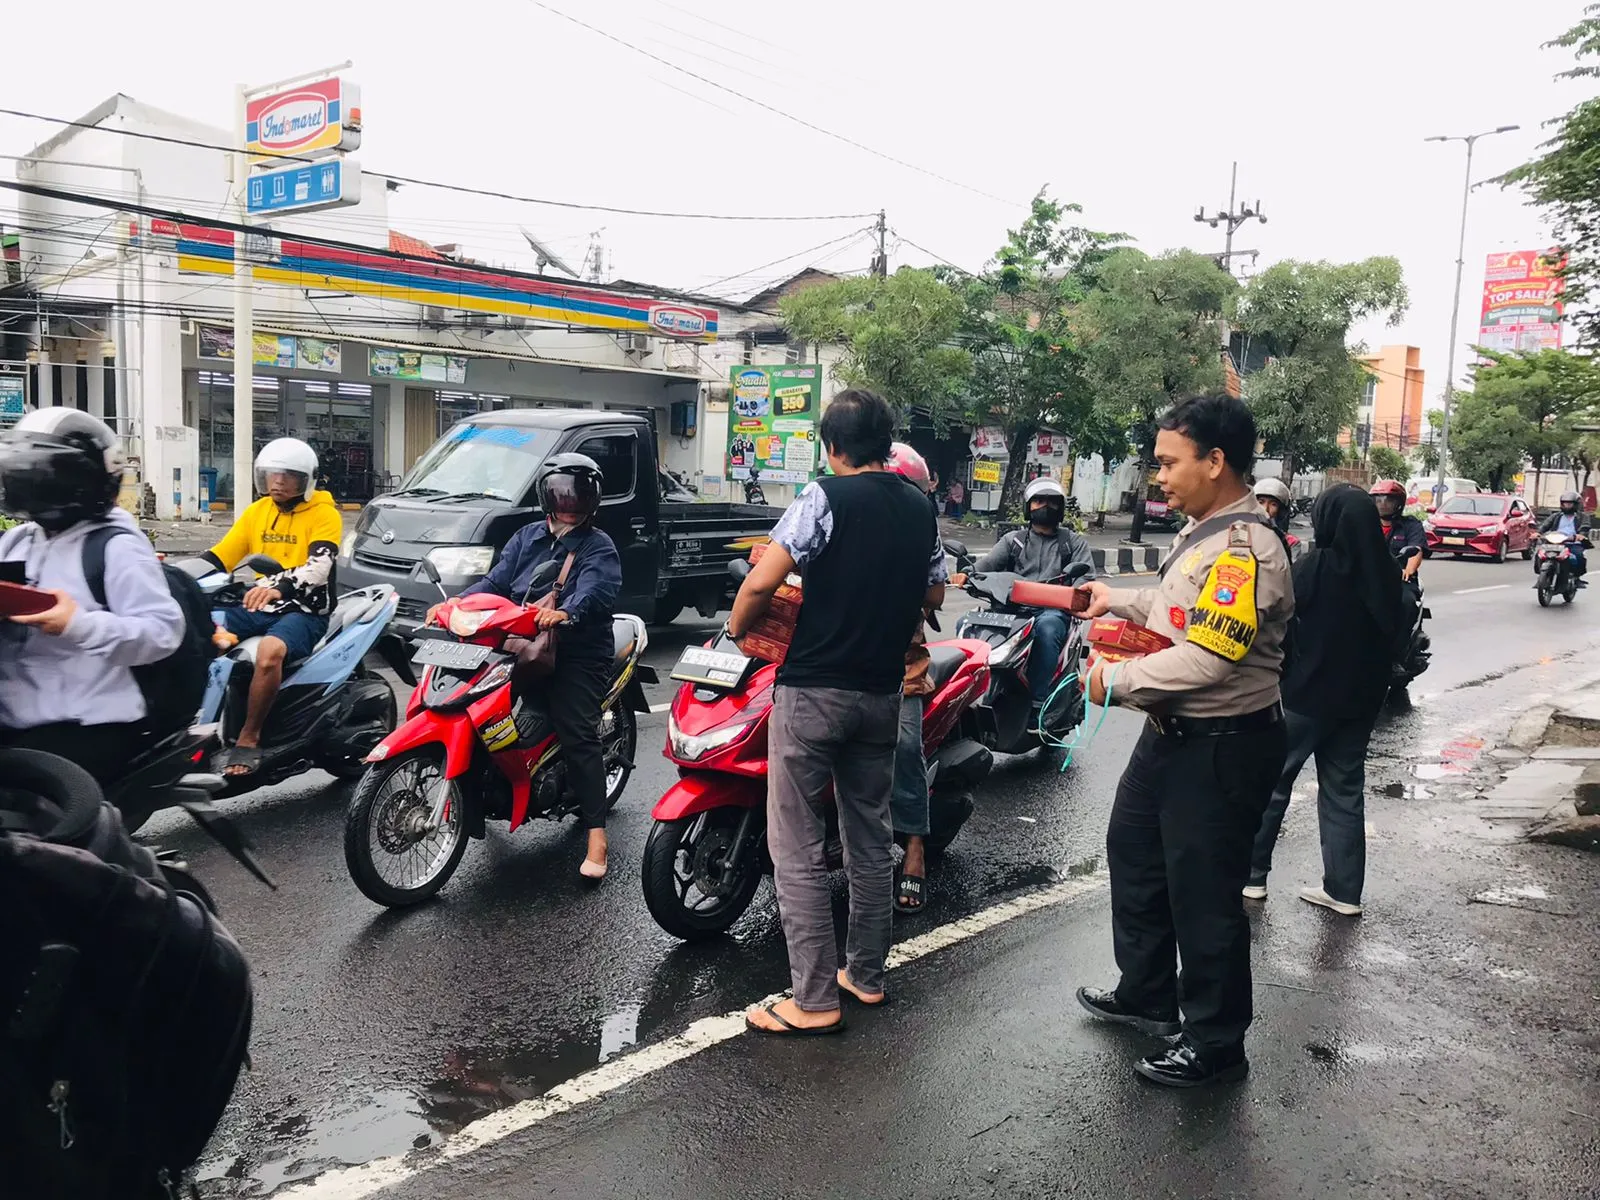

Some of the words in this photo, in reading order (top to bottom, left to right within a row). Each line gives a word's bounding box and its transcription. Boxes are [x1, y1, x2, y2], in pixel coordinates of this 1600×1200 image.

[264, 106, 322, 138] Indomaret
[1489, 291, 1513, 304] TOP
[1515, 290, 1546, 299] SALE
[657, 312, 701, 330] Indomaret
[472, 648, 488, 658] TP
